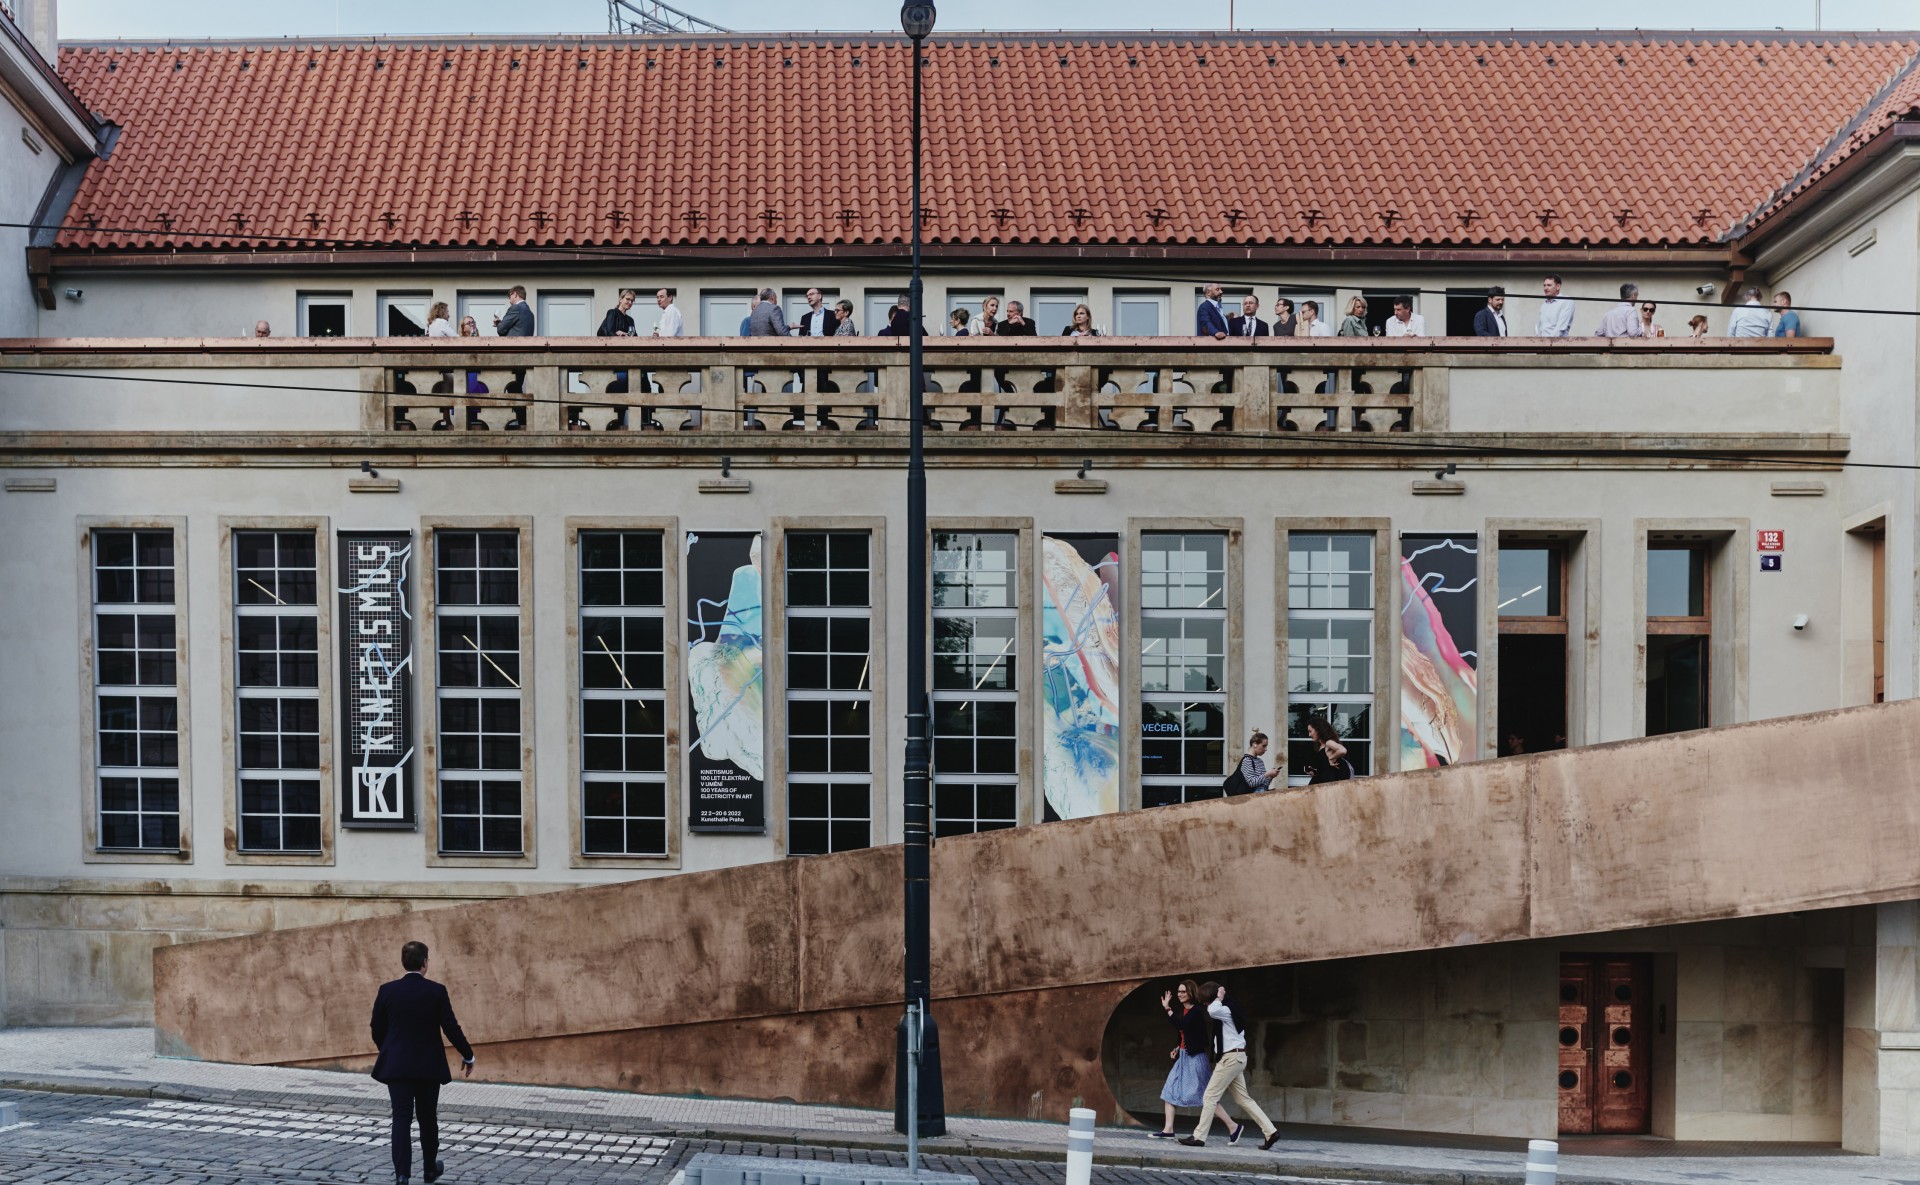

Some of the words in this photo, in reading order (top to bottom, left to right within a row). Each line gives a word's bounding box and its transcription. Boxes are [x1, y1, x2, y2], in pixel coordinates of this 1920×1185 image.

[1764, 532, 1778, 542] 132
[1768, 558, 1774, 567] 5
[358, 545, 394, 750] KINETISMUS
[1142, 723, 1180, 732] VEČERA
